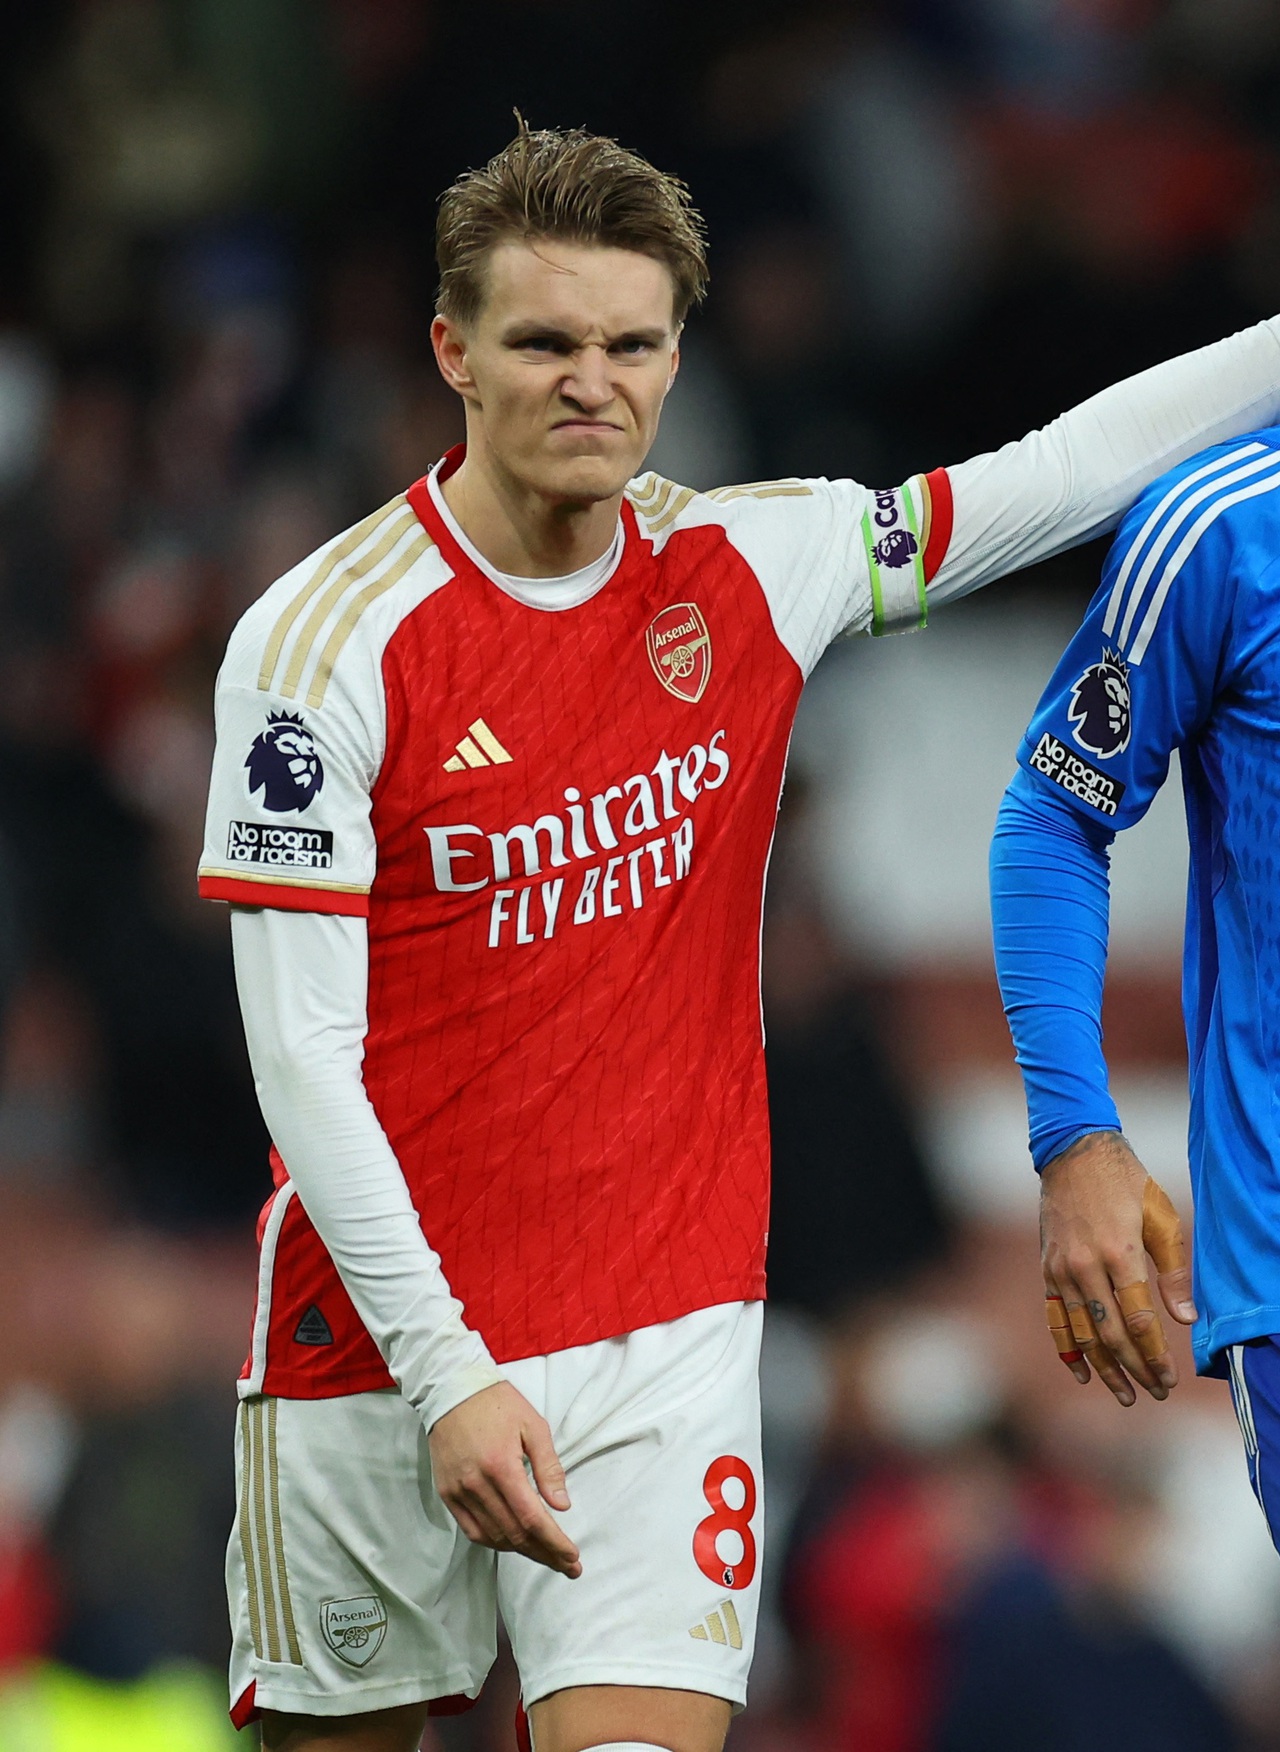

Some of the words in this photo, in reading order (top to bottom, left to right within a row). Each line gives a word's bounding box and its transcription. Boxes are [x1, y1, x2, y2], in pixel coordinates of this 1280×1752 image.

[655, 616, 697, 650] Arsenal
[1029, 748, 1059, 777] for
[1055, 769, 1118, 816] racism
[1036, 732, 1066, 763] No
[1064, 755, 1115, 797] room
[229, 821, 259, 844] No
[261, 829, 322, 849] room
[423, 729, 730, 893] Emirates
[227, 839, 258, 861] for
[259, 846, 332, 868] racism
[488, 877, 564, 948] FLY
[692, 1454, 757, 1591] 8
[329, 1606, 378, 1623] Arsenal
